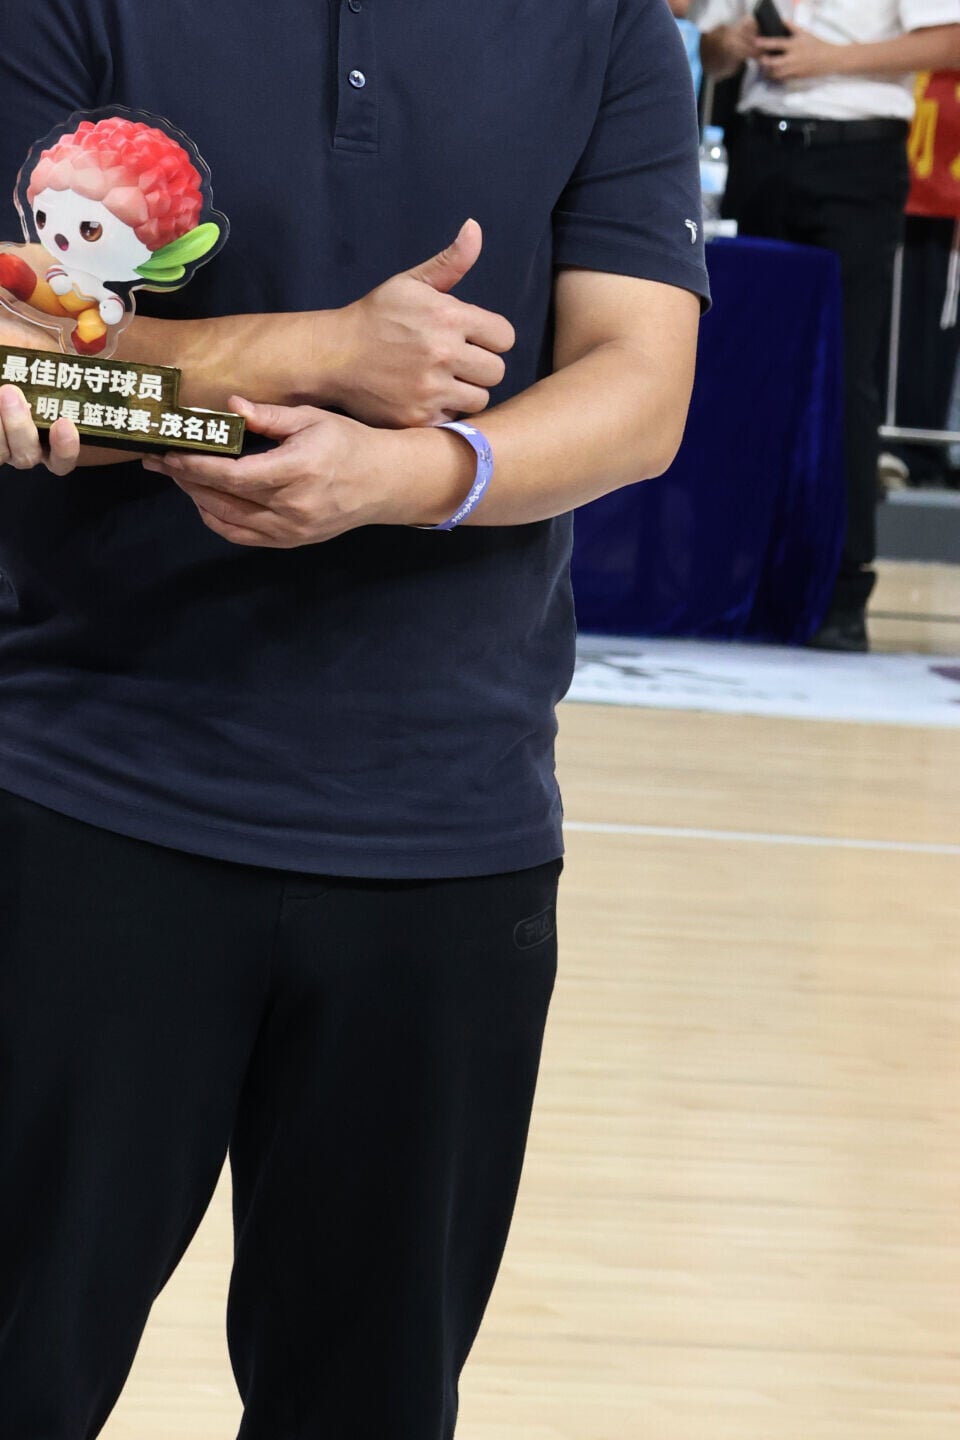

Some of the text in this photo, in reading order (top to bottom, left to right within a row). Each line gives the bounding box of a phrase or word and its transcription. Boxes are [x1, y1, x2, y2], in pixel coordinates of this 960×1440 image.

[1, 354, 163, 402] 最佳防守球员
